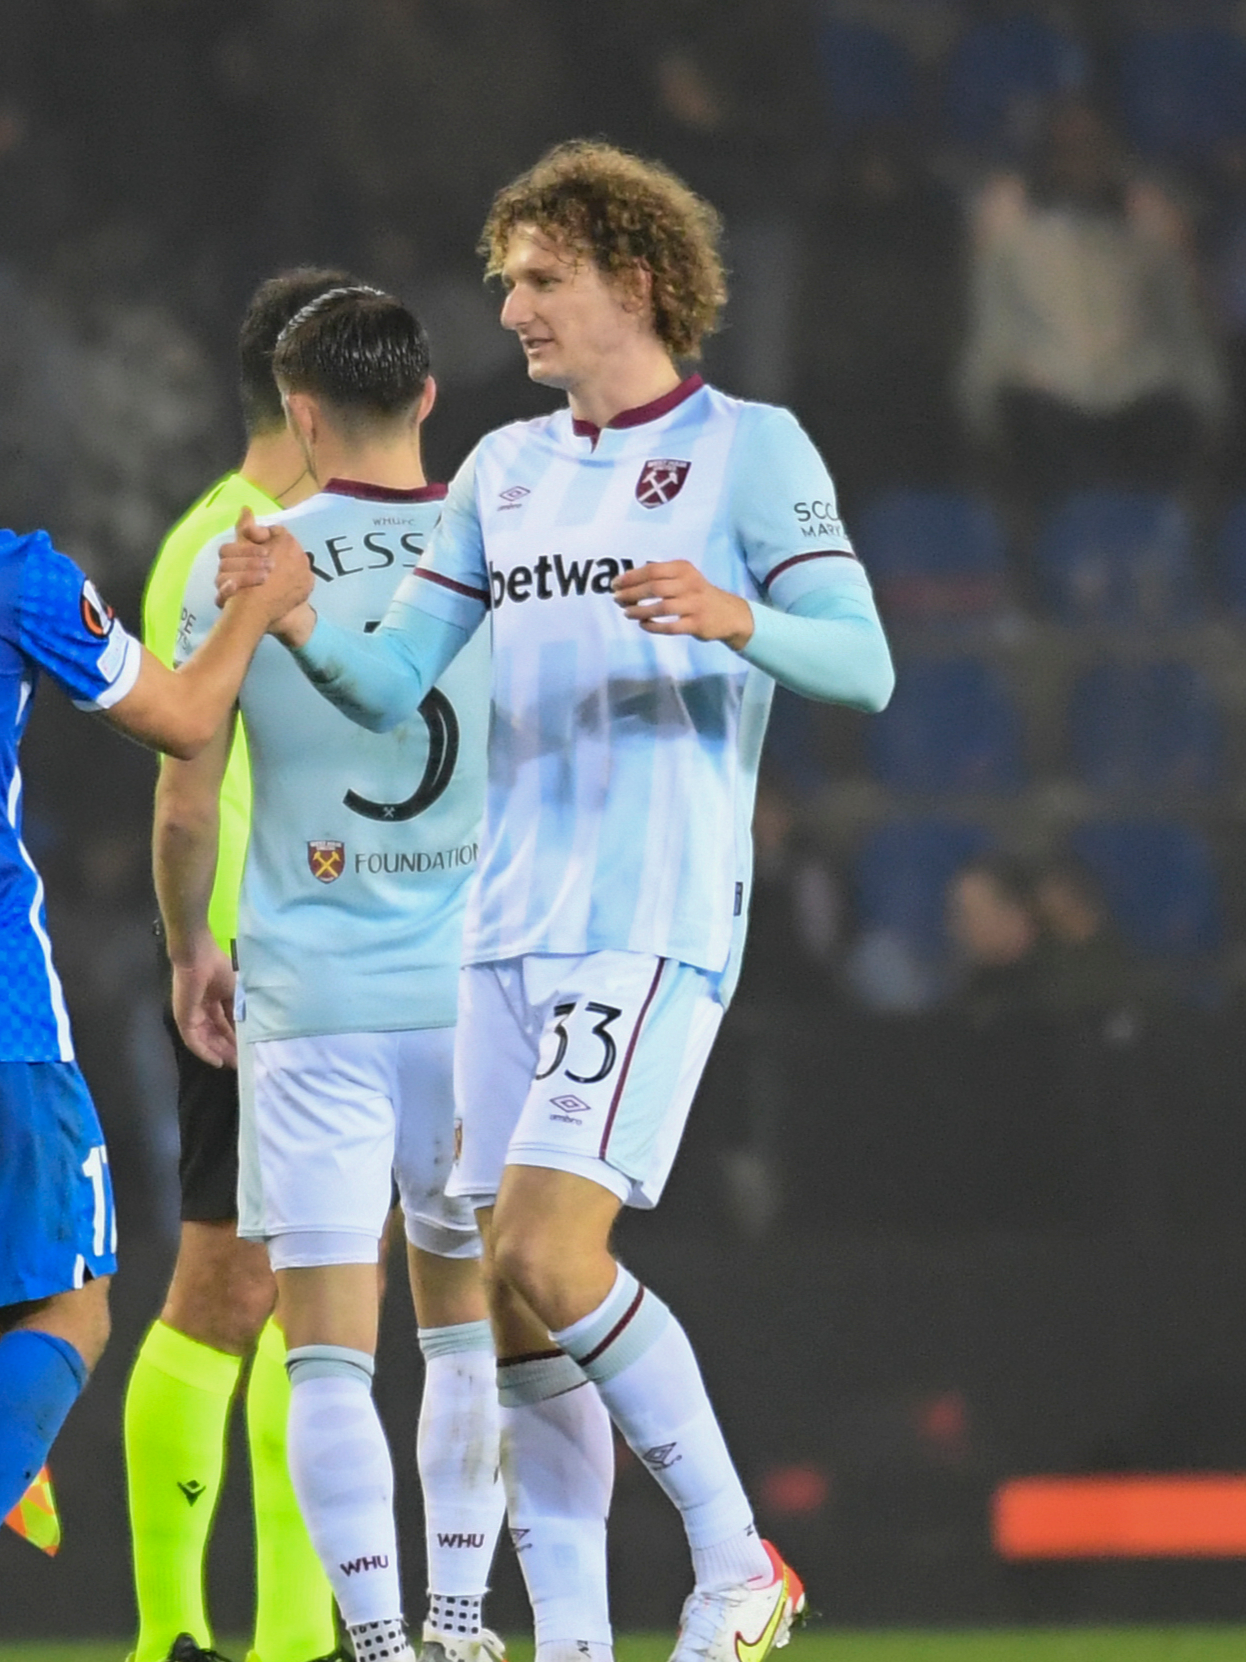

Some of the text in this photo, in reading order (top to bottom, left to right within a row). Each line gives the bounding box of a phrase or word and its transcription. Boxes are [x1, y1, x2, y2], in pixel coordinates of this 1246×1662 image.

[535, 1001, 622, 1083] 33
[437, 1533, 484, 1548] WHU
[340, 1555, 388, 1577] WHU
